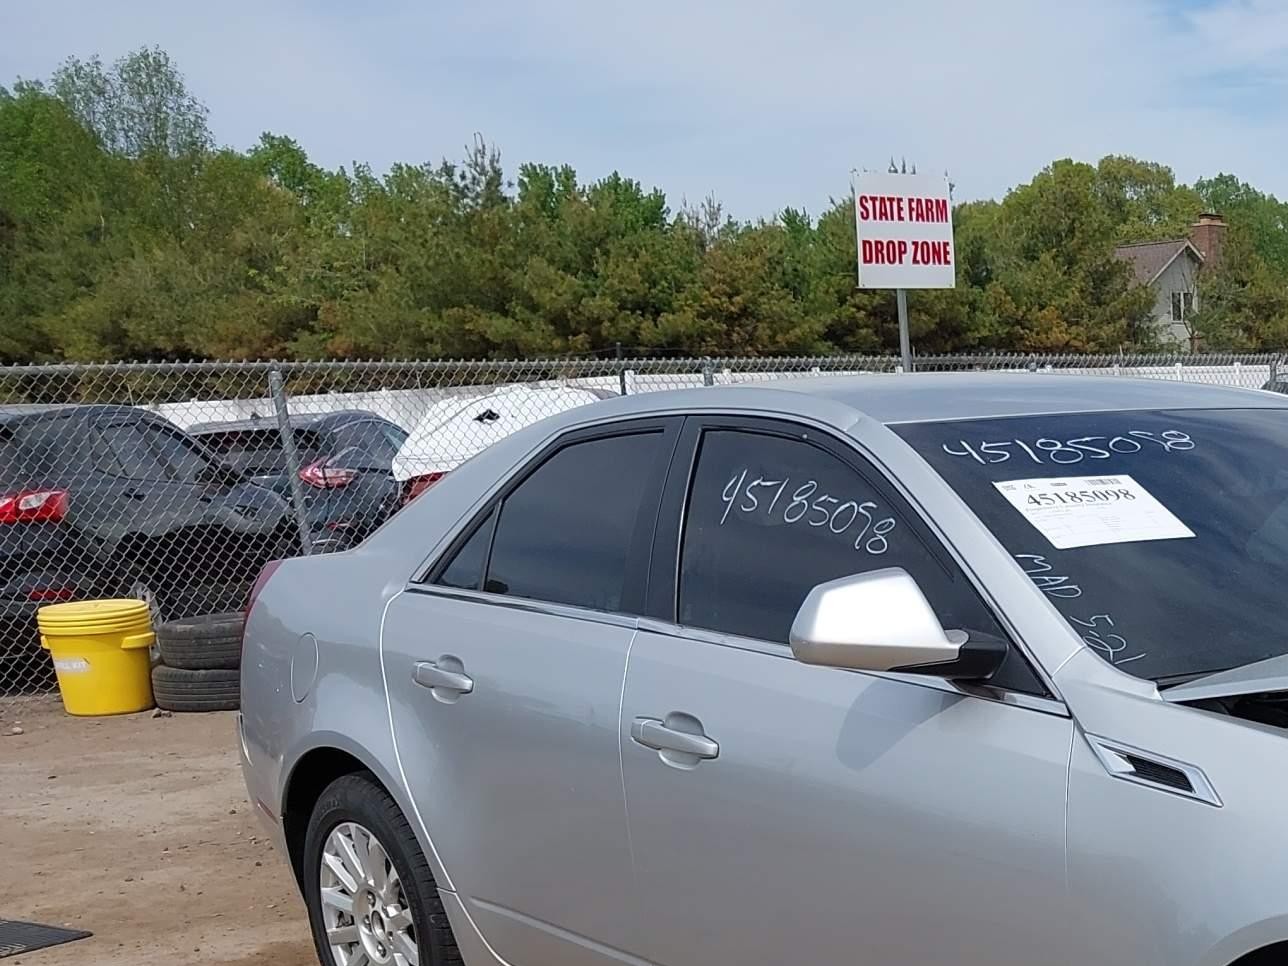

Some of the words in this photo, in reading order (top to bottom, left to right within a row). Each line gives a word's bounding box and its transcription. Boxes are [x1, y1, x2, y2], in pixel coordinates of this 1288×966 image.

[859, 195, 904, 222] STATE
[907, 198, 948, 223] FARM
[862, 240, 907, 265] DROP
[912, 241, 951, 265] ZONE
[942, 430, 1195, 464] 45185098
[1027, 488, 1136, 506] 45185098
[720, 469, 896, 554] 45185098
